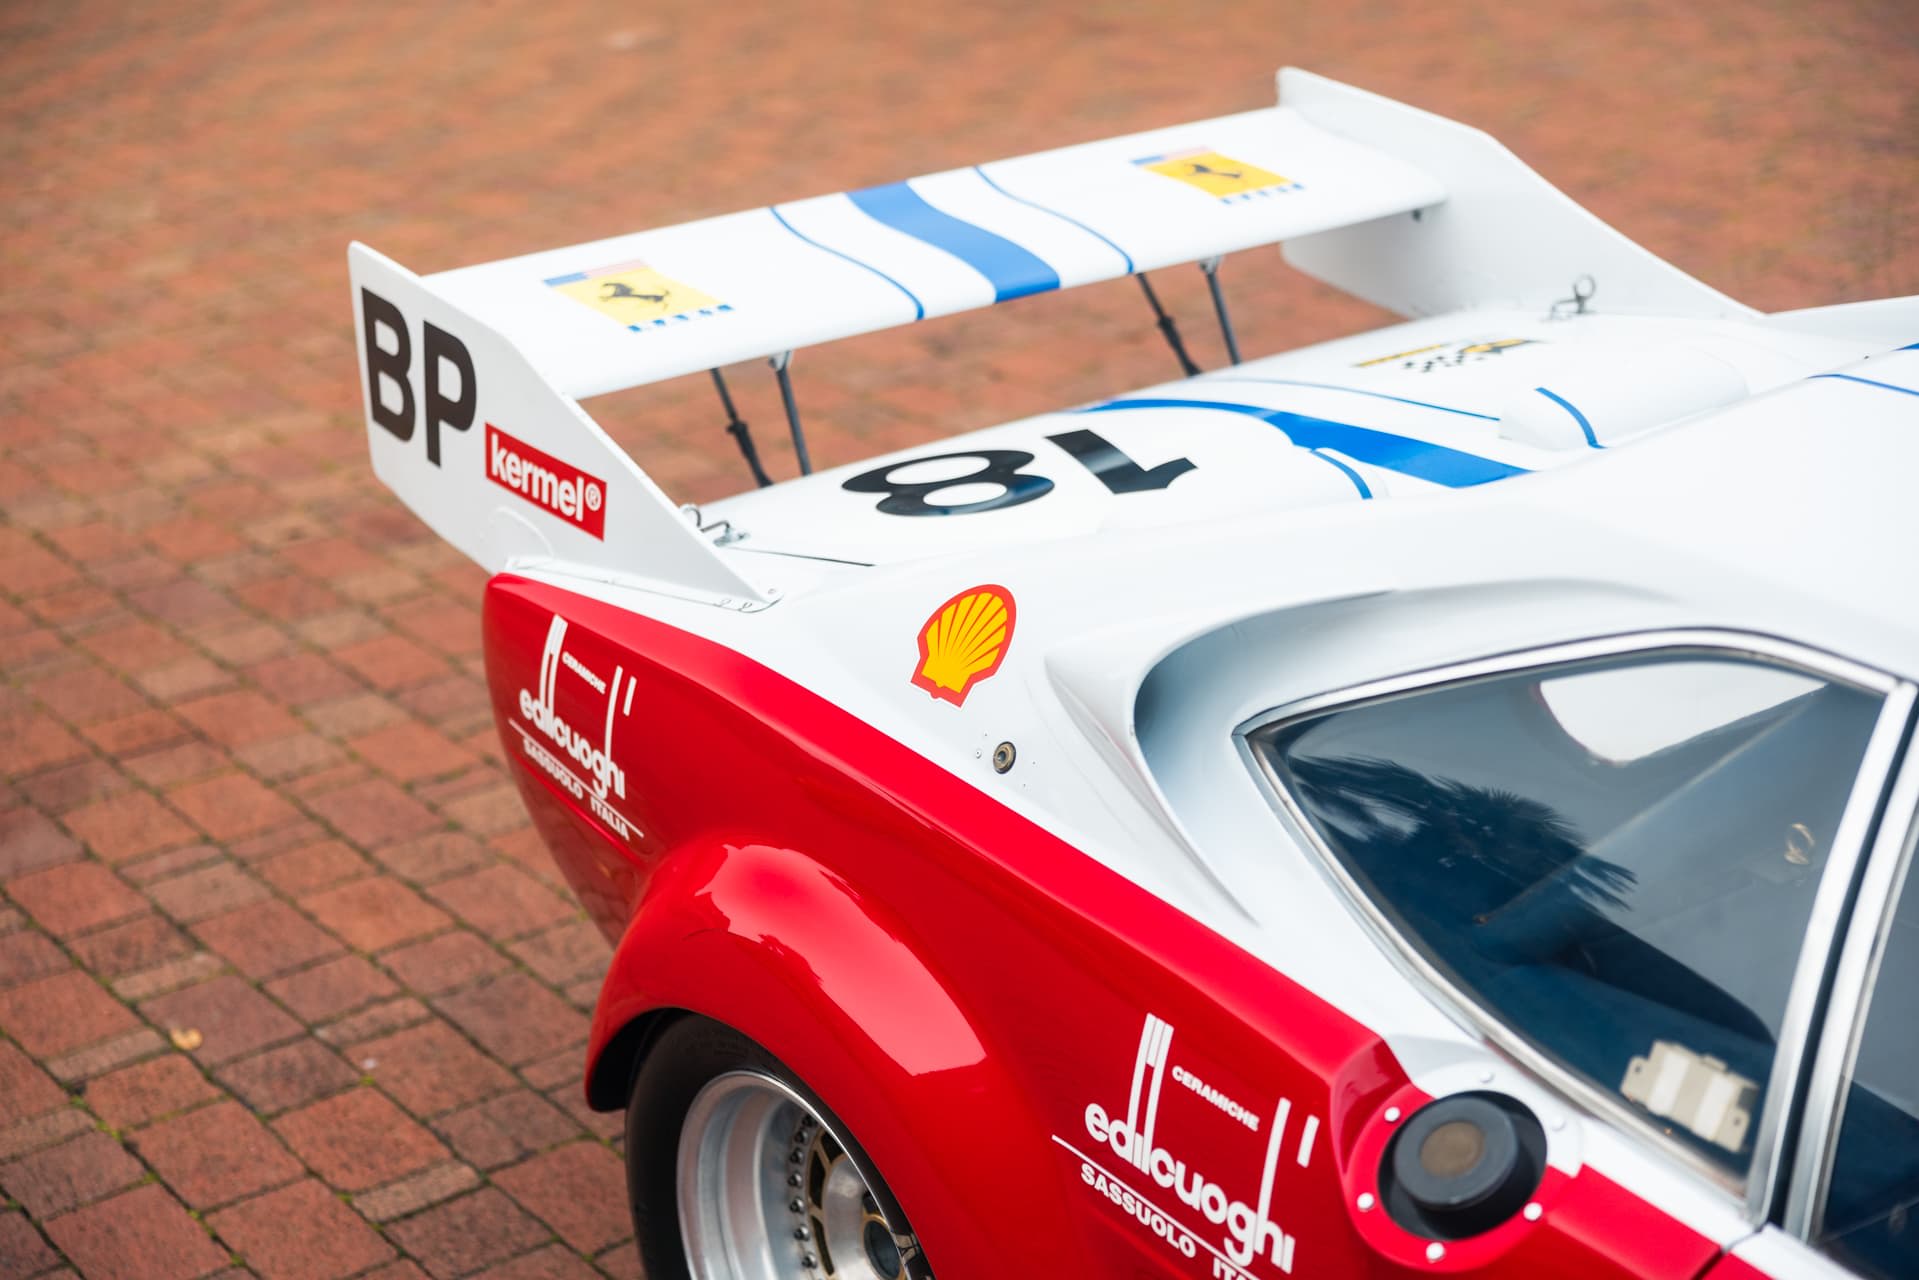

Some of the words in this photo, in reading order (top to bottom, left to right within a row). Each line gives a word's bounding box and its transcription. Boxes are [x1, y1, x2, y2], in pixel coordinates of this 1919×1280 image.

[361, 287, 477, 468] BP
[842, 429, 1199, 517] 18
[591, 796, 630, 841] ITALIA
[1172, 1065, 1260, 1132] CERAMICHE
[1081, 1163, 1197, 1258] SASSUOLO
